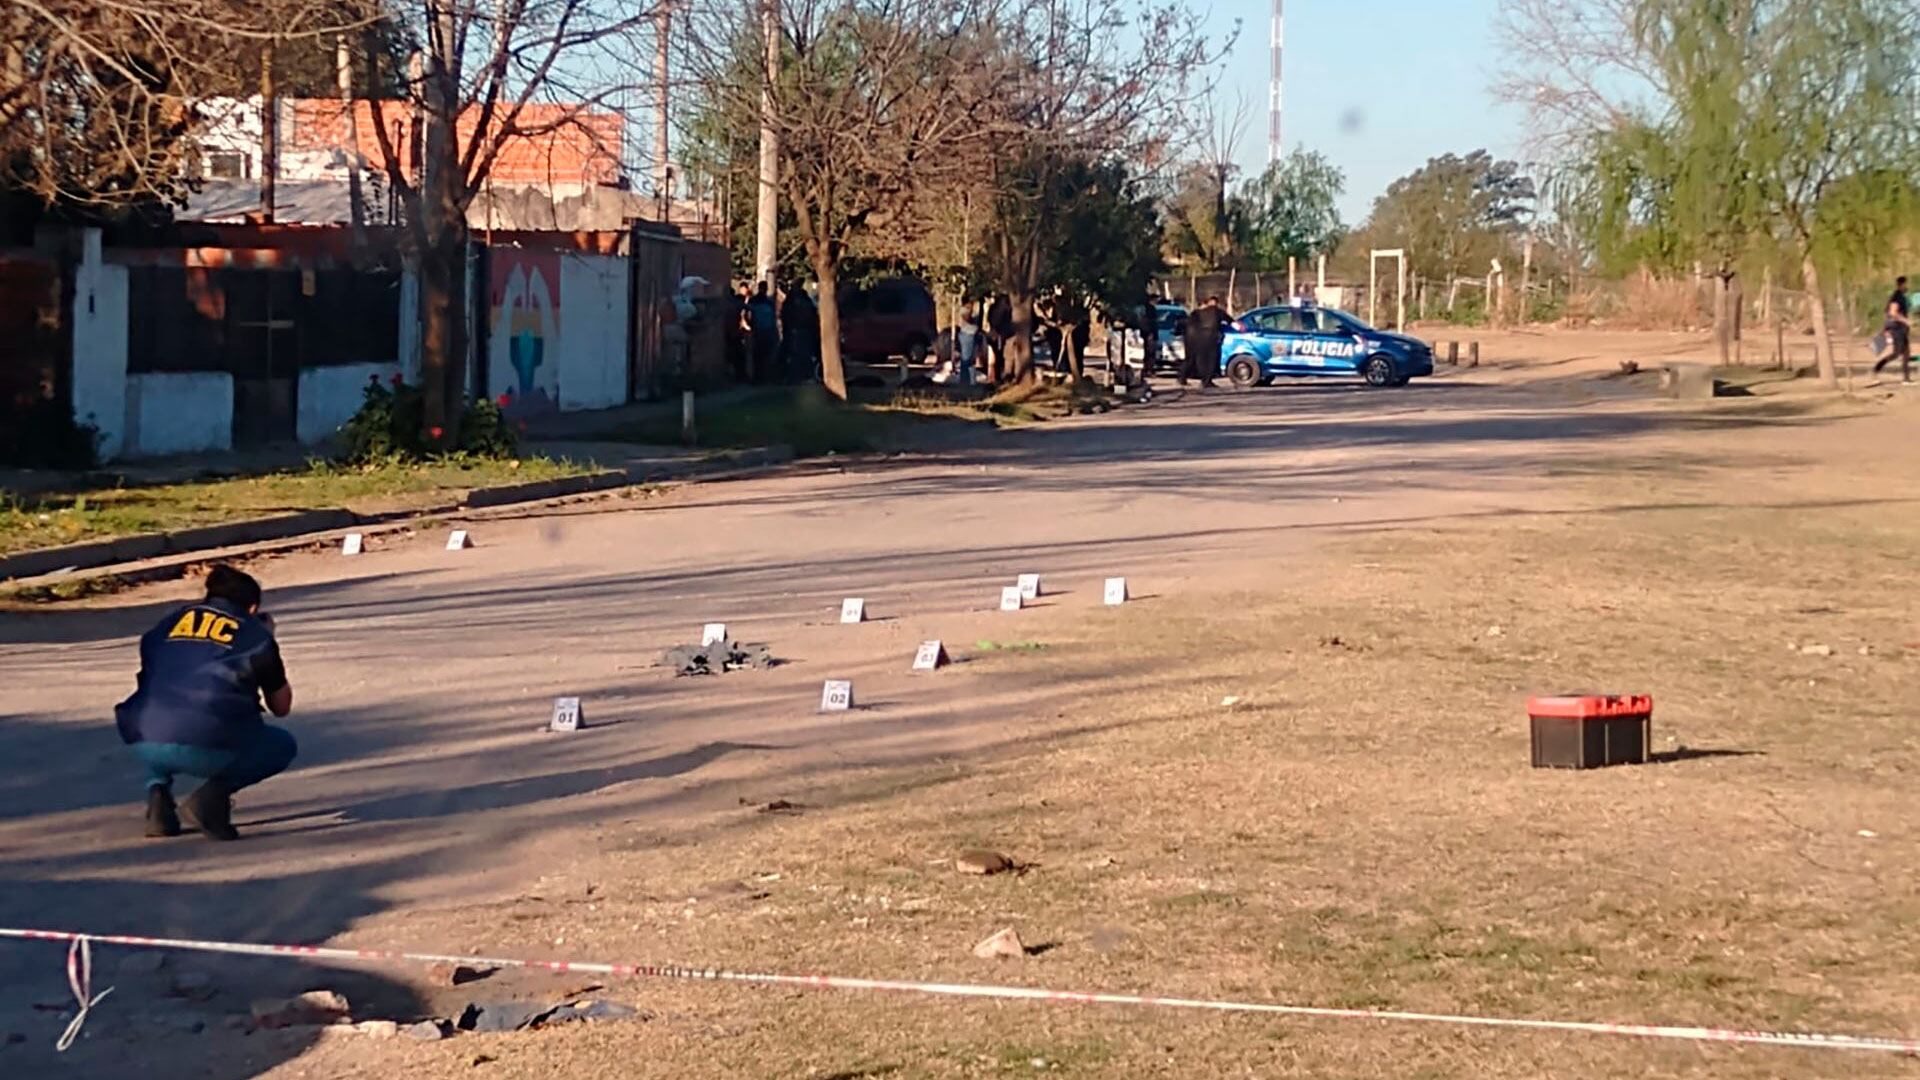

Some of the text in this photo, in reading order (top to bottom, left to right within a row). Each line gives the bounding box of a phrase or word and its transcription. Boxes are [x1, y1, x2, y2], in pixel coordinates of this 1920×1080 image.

[1292, 339, 1354, 357] POLICIA
[168, 610, 240, 642] AIC
[830, 693, 846, 704] 02
[558, 712, 573, 723] 01
